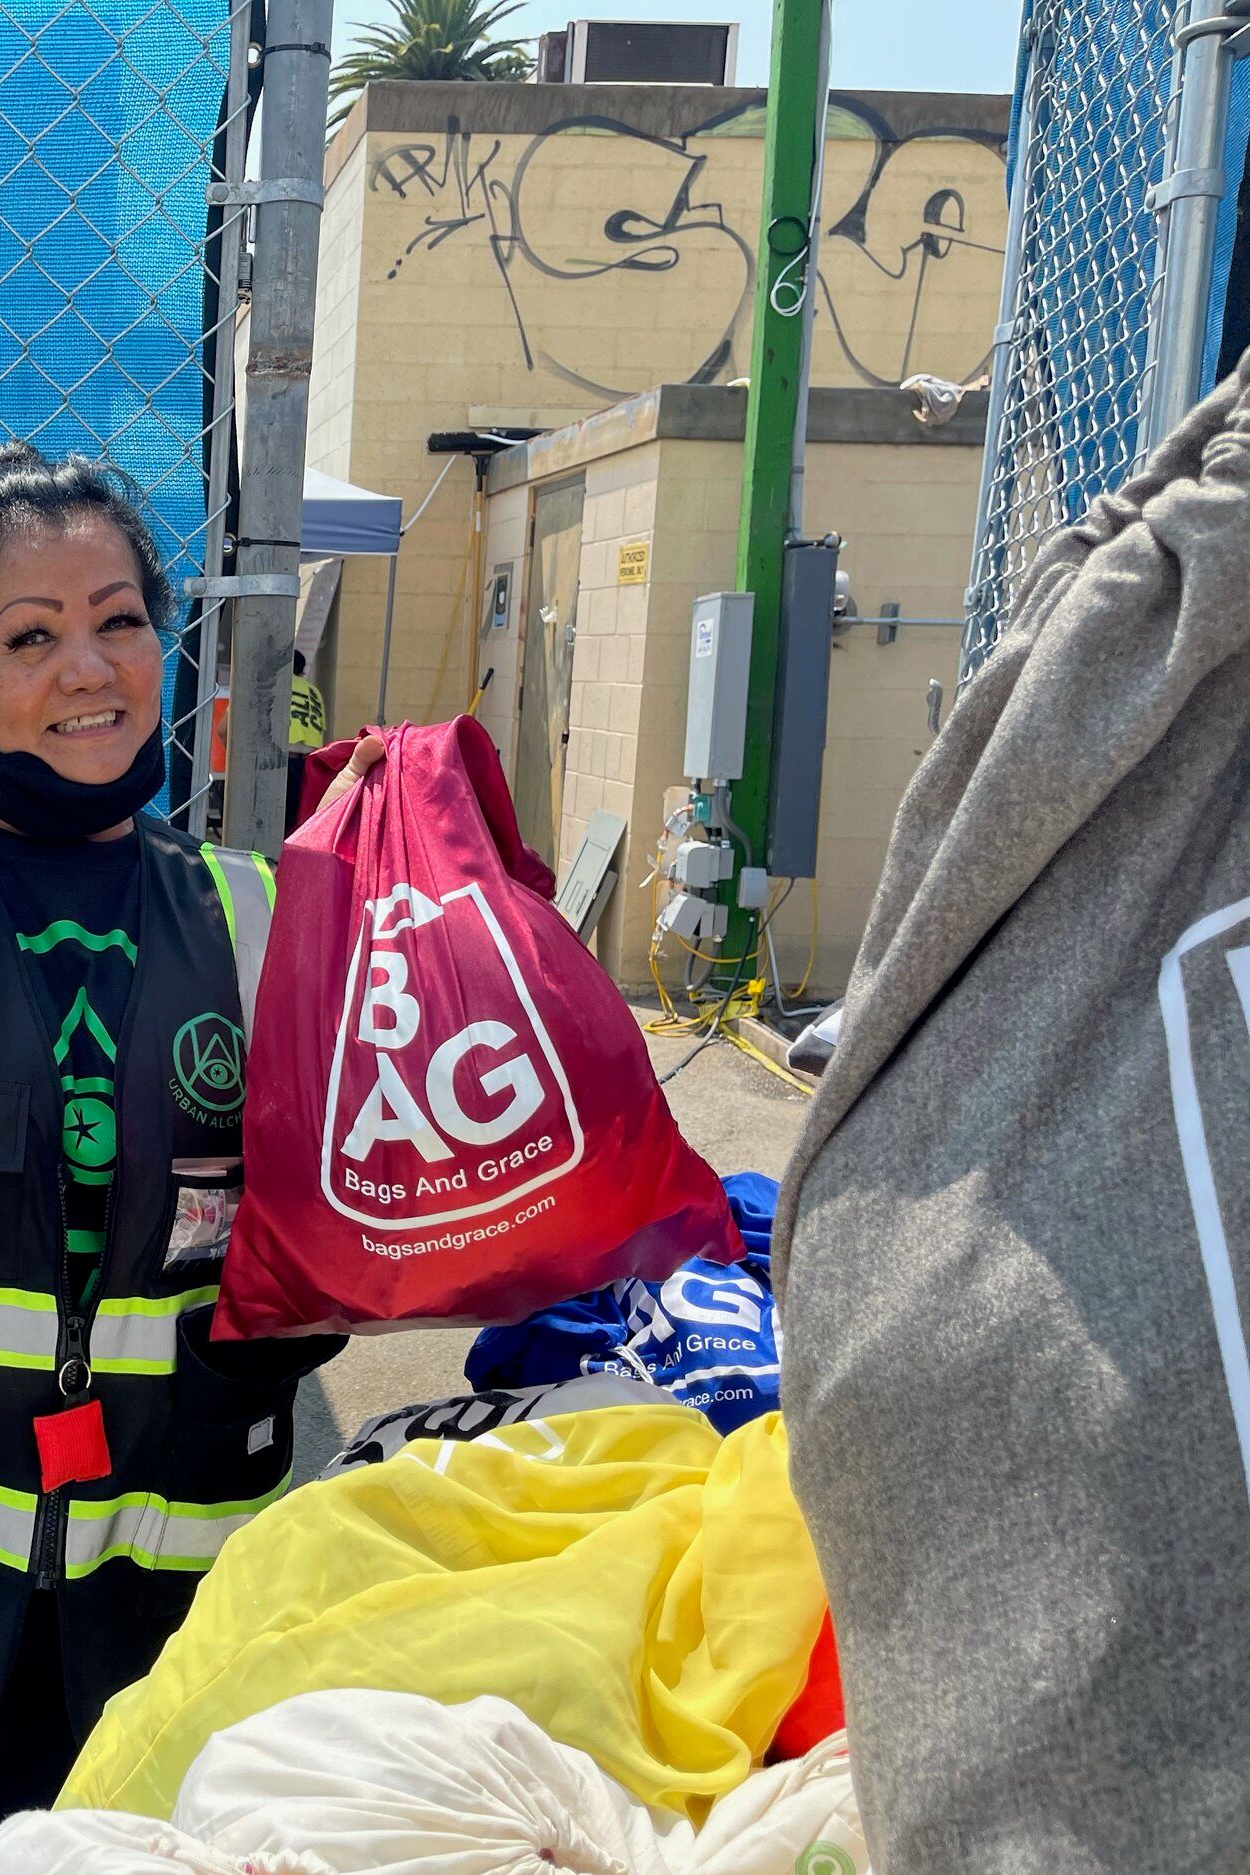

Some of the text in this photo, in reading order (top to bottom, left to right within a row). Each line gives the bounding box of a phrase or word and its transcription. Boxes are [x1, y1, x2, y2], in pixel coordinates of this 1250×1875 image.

[358, 950, 420, 1049] B
[168, 1078, 208, 1124] URBAN
[340, 1020, 546, 1163] AG
[345, 1135, 554, 1204] Bags And Grace
[361, 1195, 556, 1260] bagsandgrace.com
[686, 1334, 757, 1352] Grace
[677, 1387, 753, 1408] race.com
